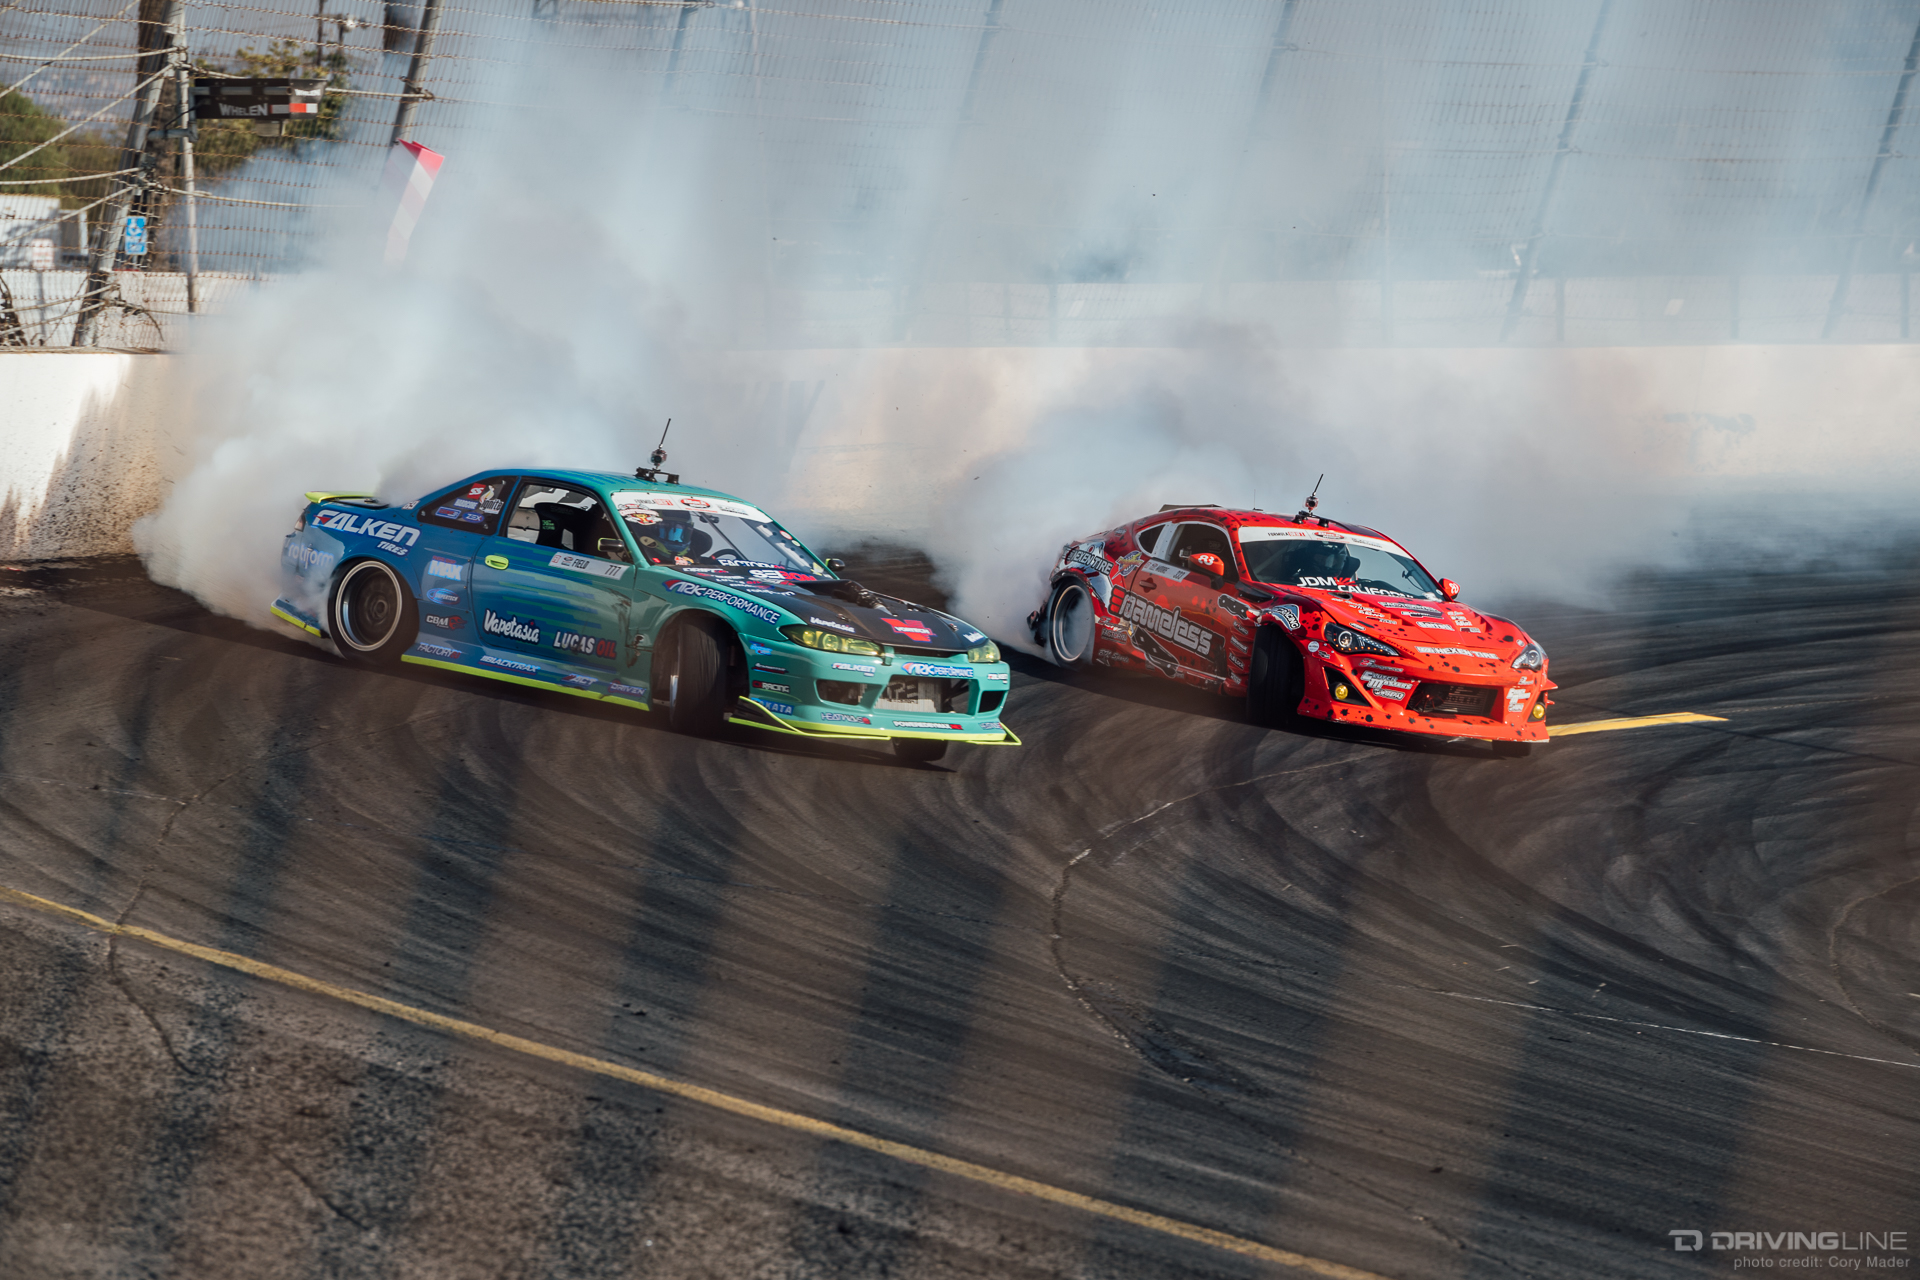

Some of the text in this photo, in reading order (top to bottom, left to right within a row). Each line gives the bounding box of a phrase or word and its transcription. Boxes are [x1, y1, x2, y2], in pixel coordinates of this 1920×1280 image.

[219, 103, 268, 116] WHELEN
[312, 509, 420, 547] FALKEN
[288, 542, 334, 569] rotiform
[377, 541, 408, 556] TIRES
[428, 560, 463, 581] MAX
[572, 558, 590, 570] FIELD
[604, 564, 622, 577] 777
[1091, 556, 1113, 574] TIRE
[1297, 577, 1336, 587] JDM
[669, 581, 780, 624] ARK PERFORMANCE
[426, 615, 449, 626] CBM
[484, 609, 540, 643] Vapetasia
[553, 632, 617, 658] LUCAS OIL
[832, 662, 876, 672] FALKEN
[933, 667, 973, 678] PERFORMANCE
[610, 683, 646, 695] DRIVEN
